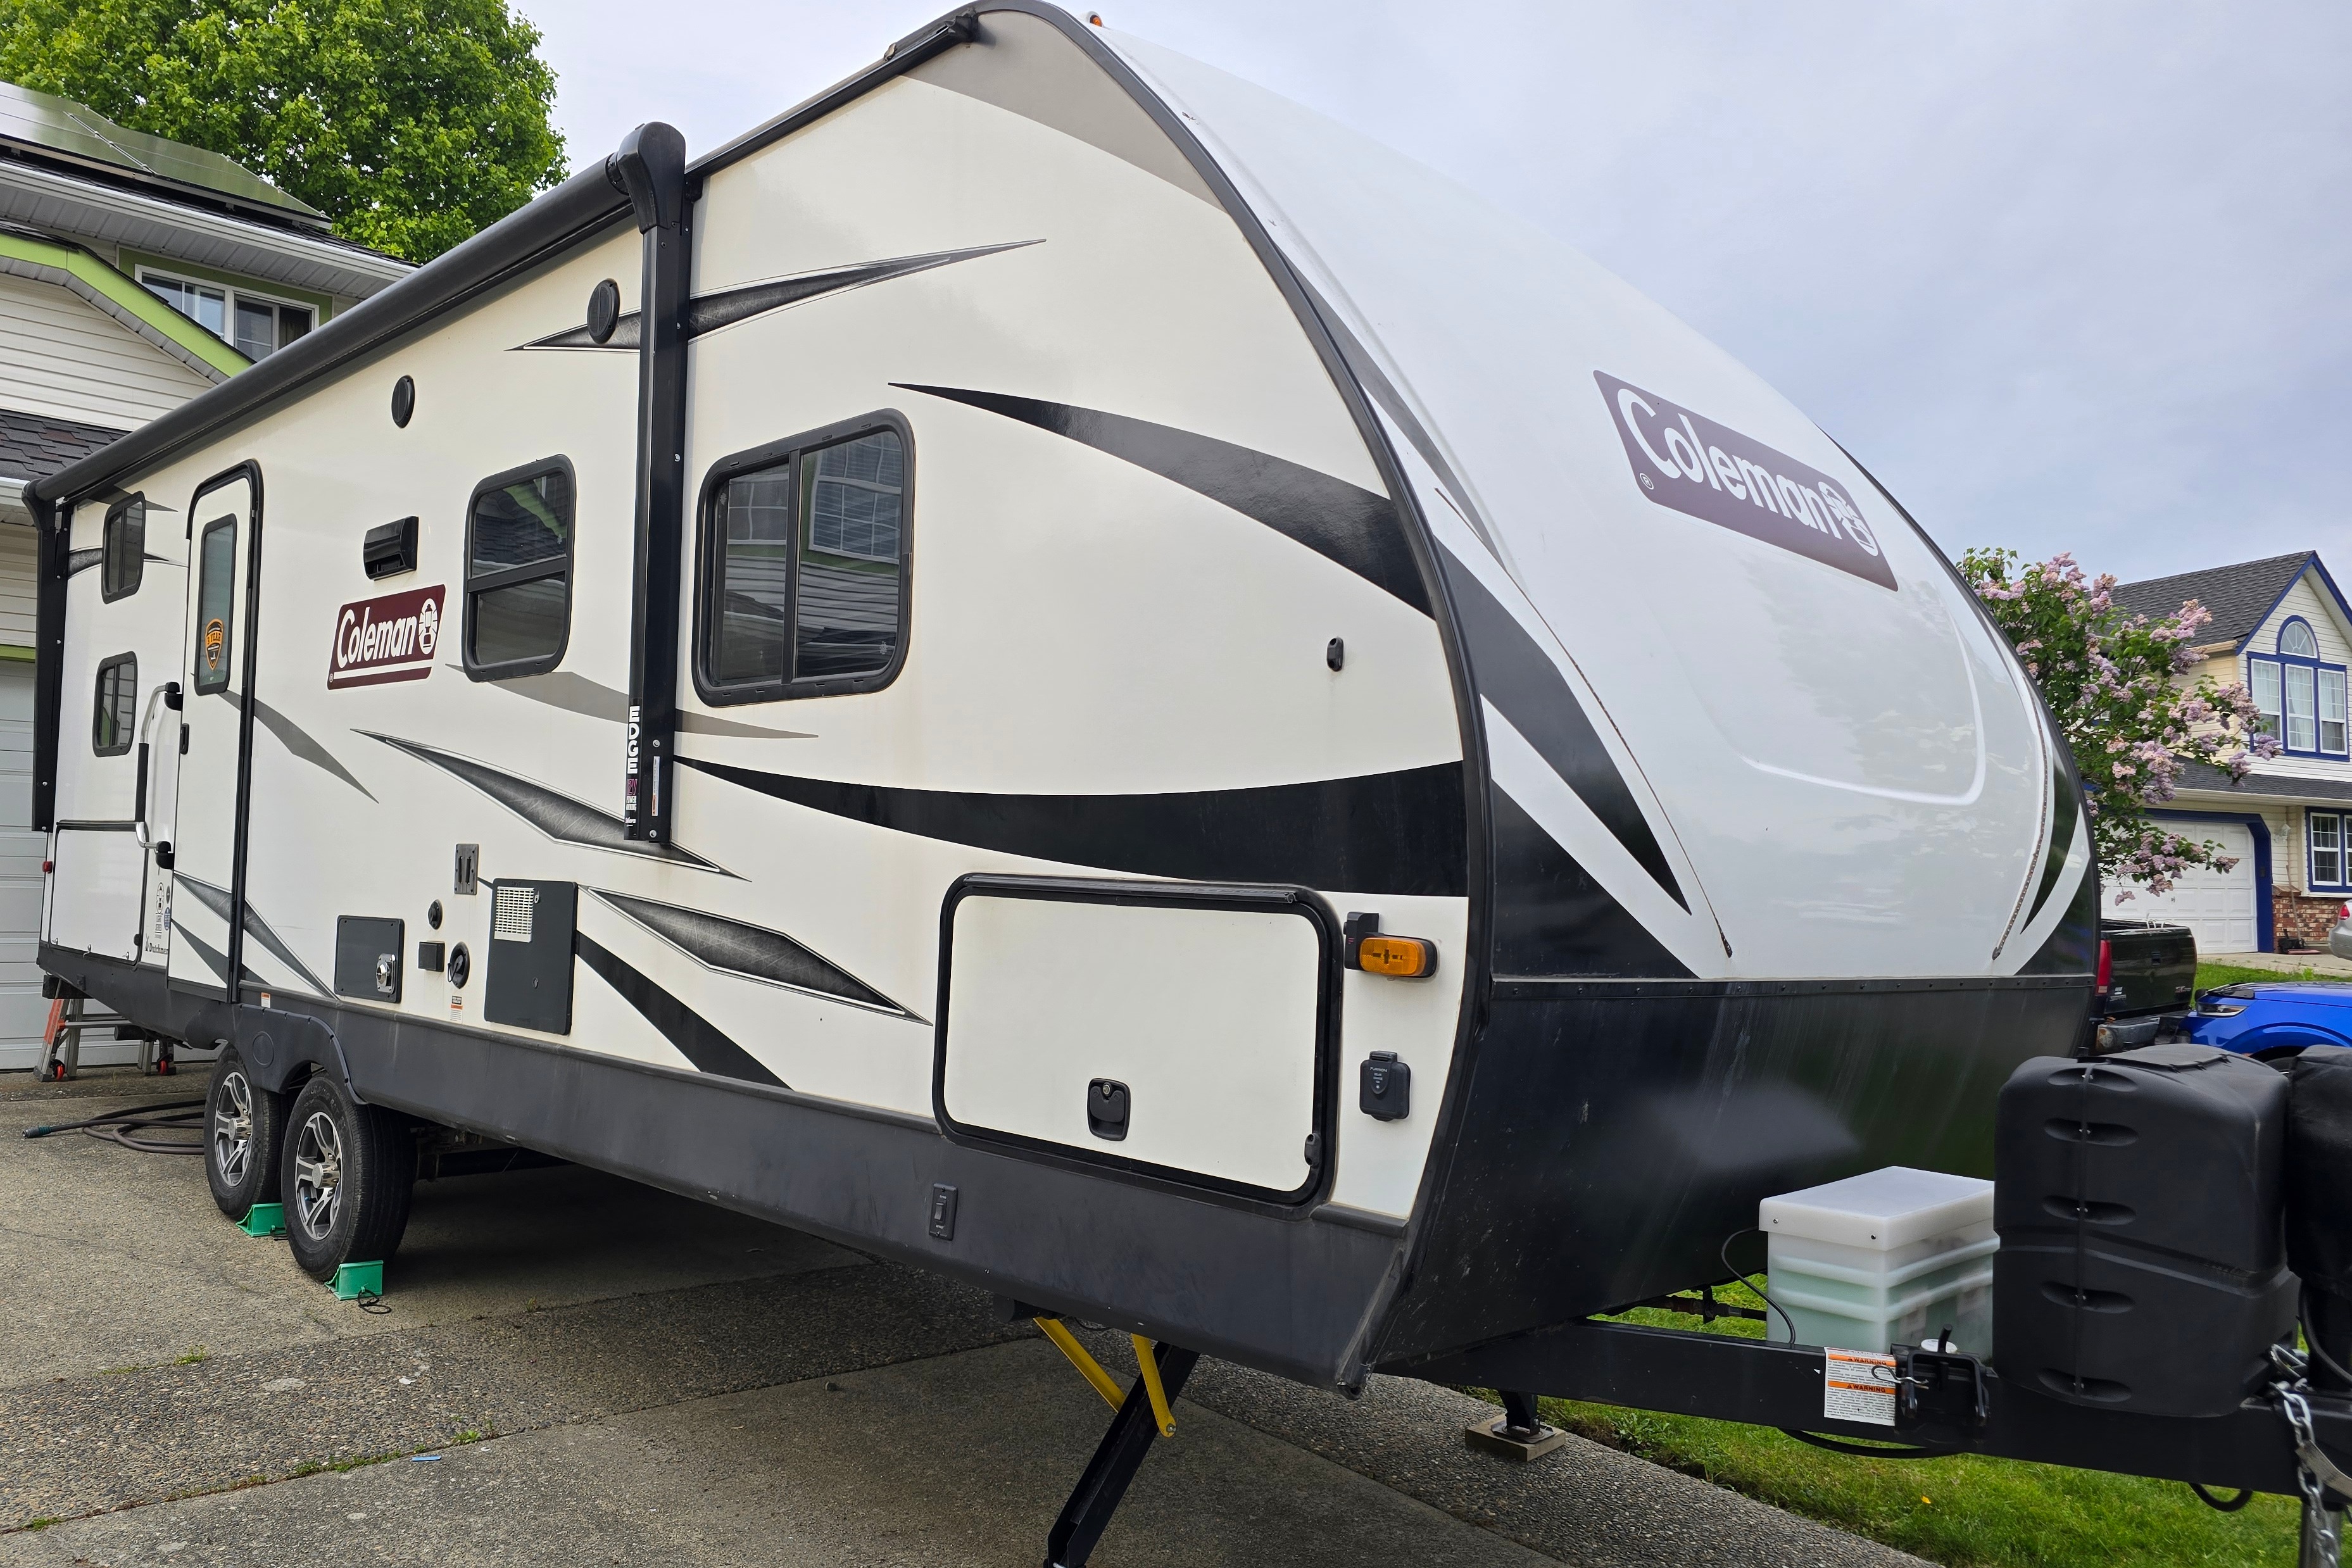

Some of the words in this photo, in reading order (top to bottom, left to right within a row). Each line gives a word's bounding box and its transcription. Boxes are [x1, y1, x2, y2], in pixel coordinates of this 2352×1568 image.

[1618, 388, 1842, 540] Coleman
[337, 606, 417, 668] Coleman
[627, 705, 640, 774] EDGE
[1853, 1384, 1886, 1393] WARNING
[1854, 1357, 1887, 1365] WARNING
